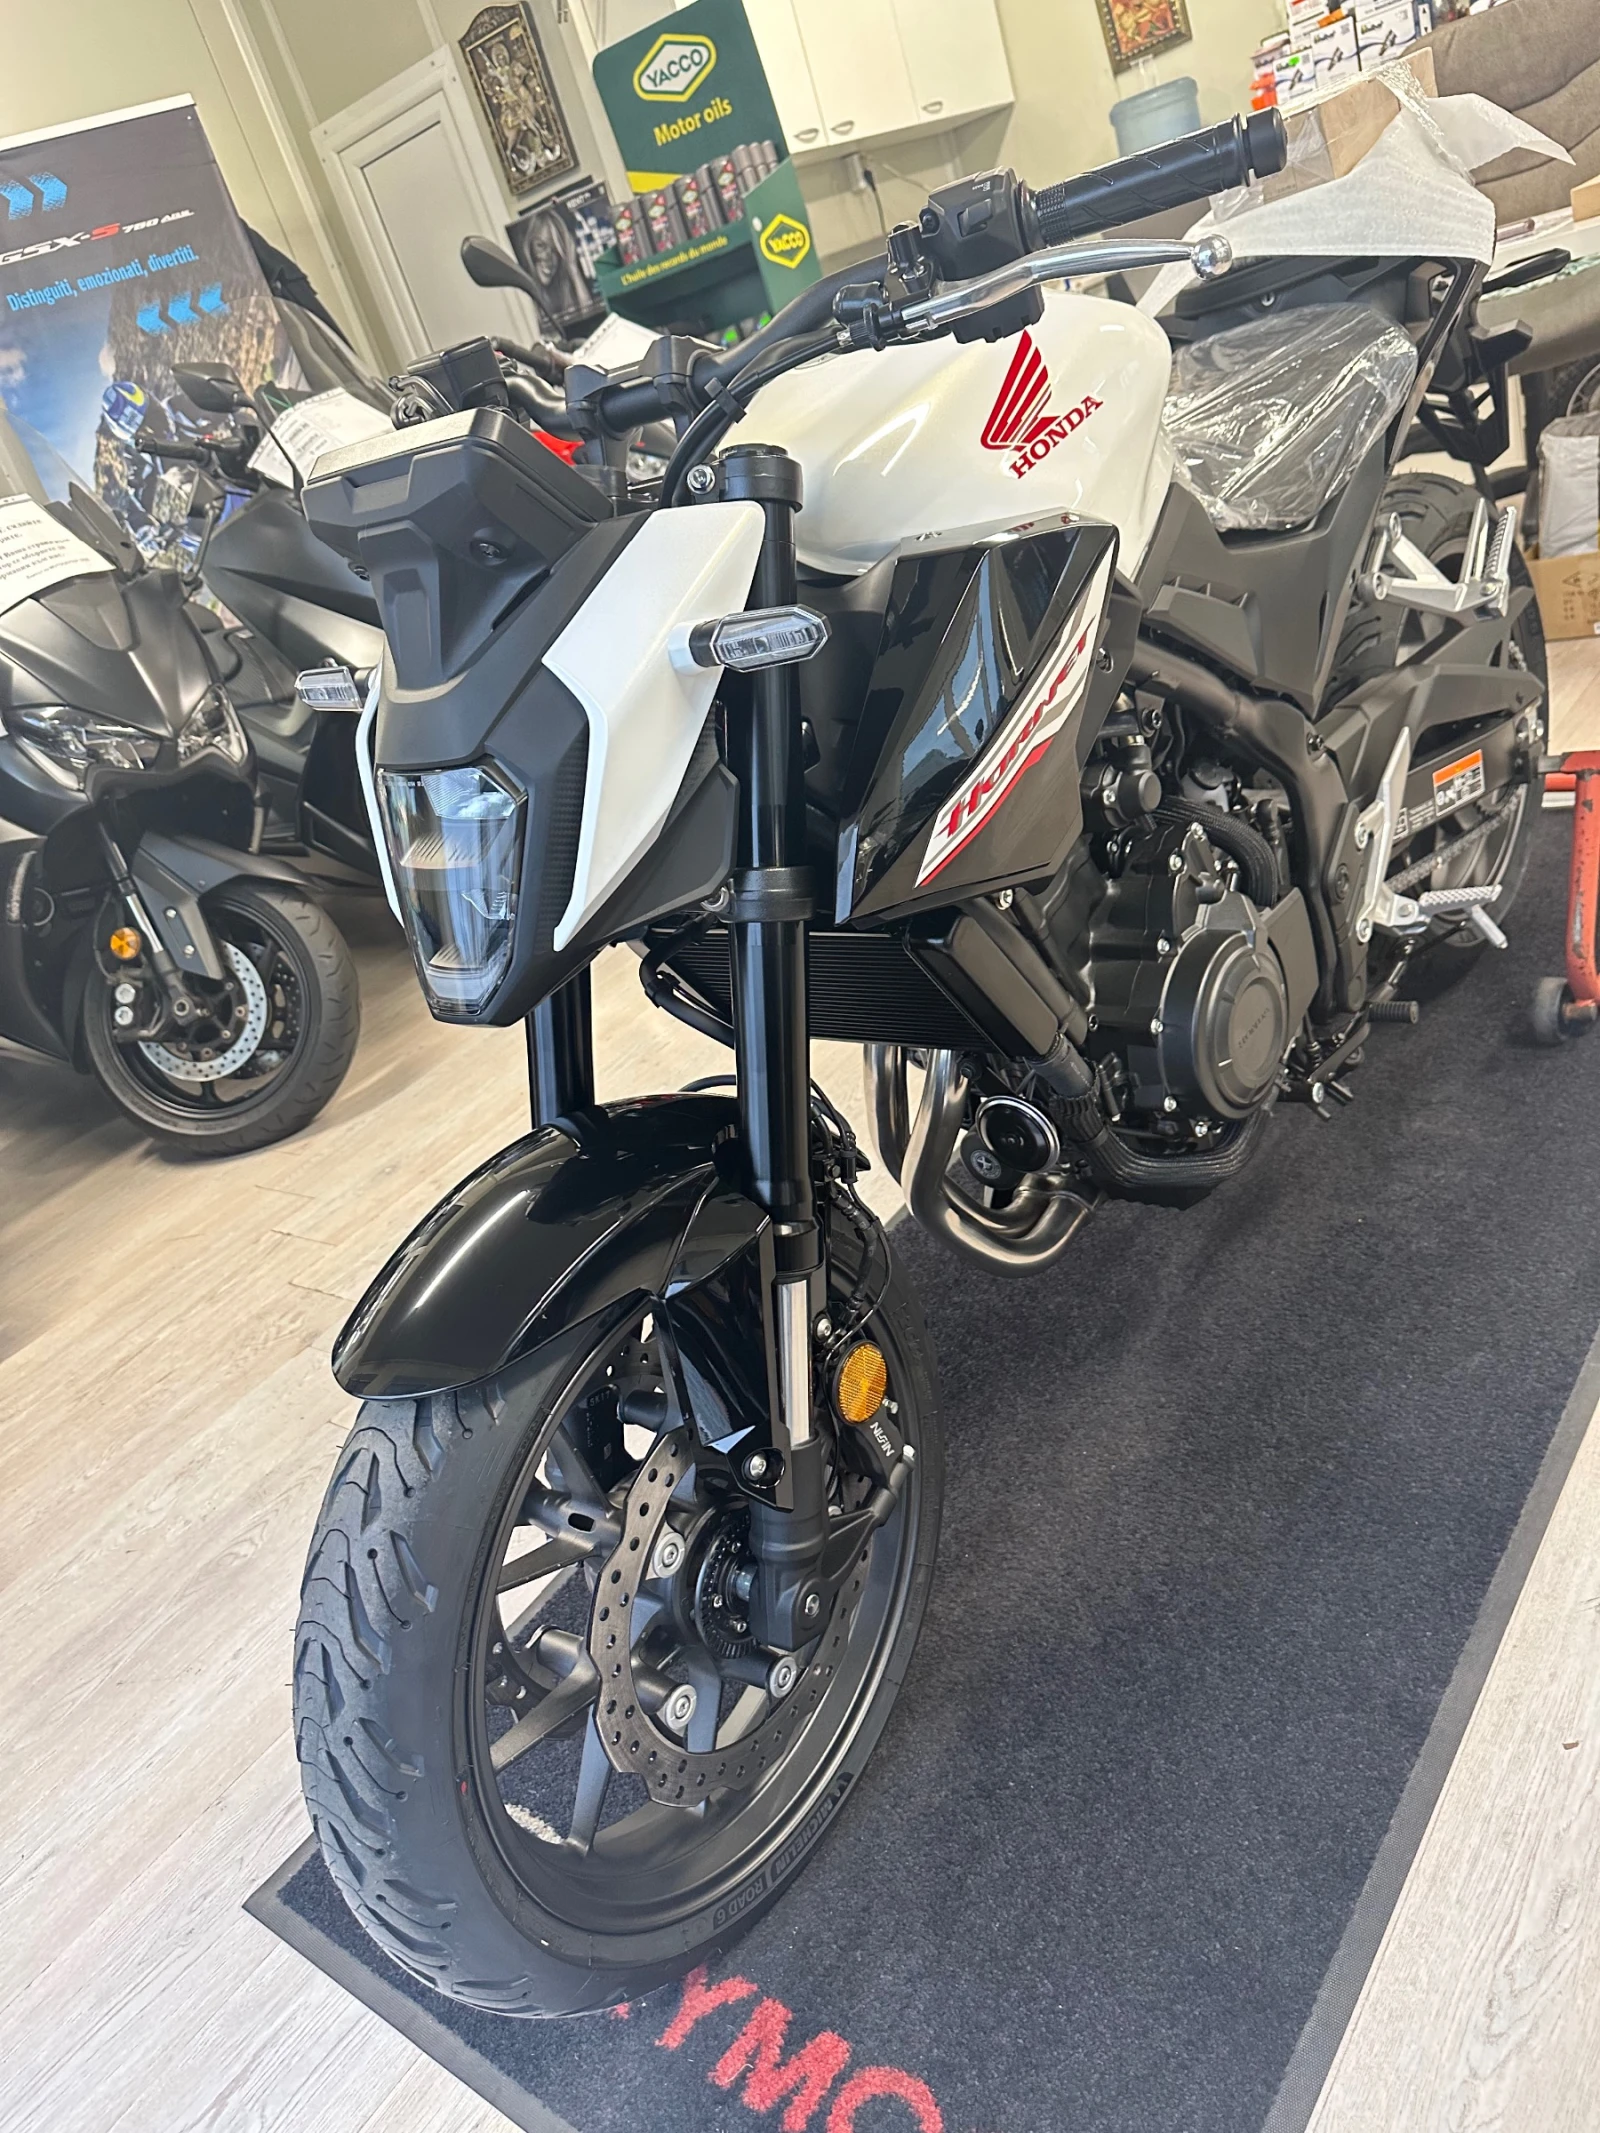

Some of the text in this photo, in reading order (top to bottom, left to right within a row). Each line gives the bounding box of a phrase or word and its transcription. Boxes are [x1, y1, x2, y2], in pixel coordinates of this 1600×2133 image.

[646, 48, 704, 88] YACCO
[652, 96, 733, 147] Motor oils
[767, 230, 804, 254] YACCO
[5, 244, 200, 313] Distinguiti, emozionati, divertiti.
[1008, 395, 1104, 480] HONDA
[869, 1421, 895, 1458] NISSIN
[774, 1797, 834, 1874] MICHELIN
[728, 1877, 766, 1917] ROAD
